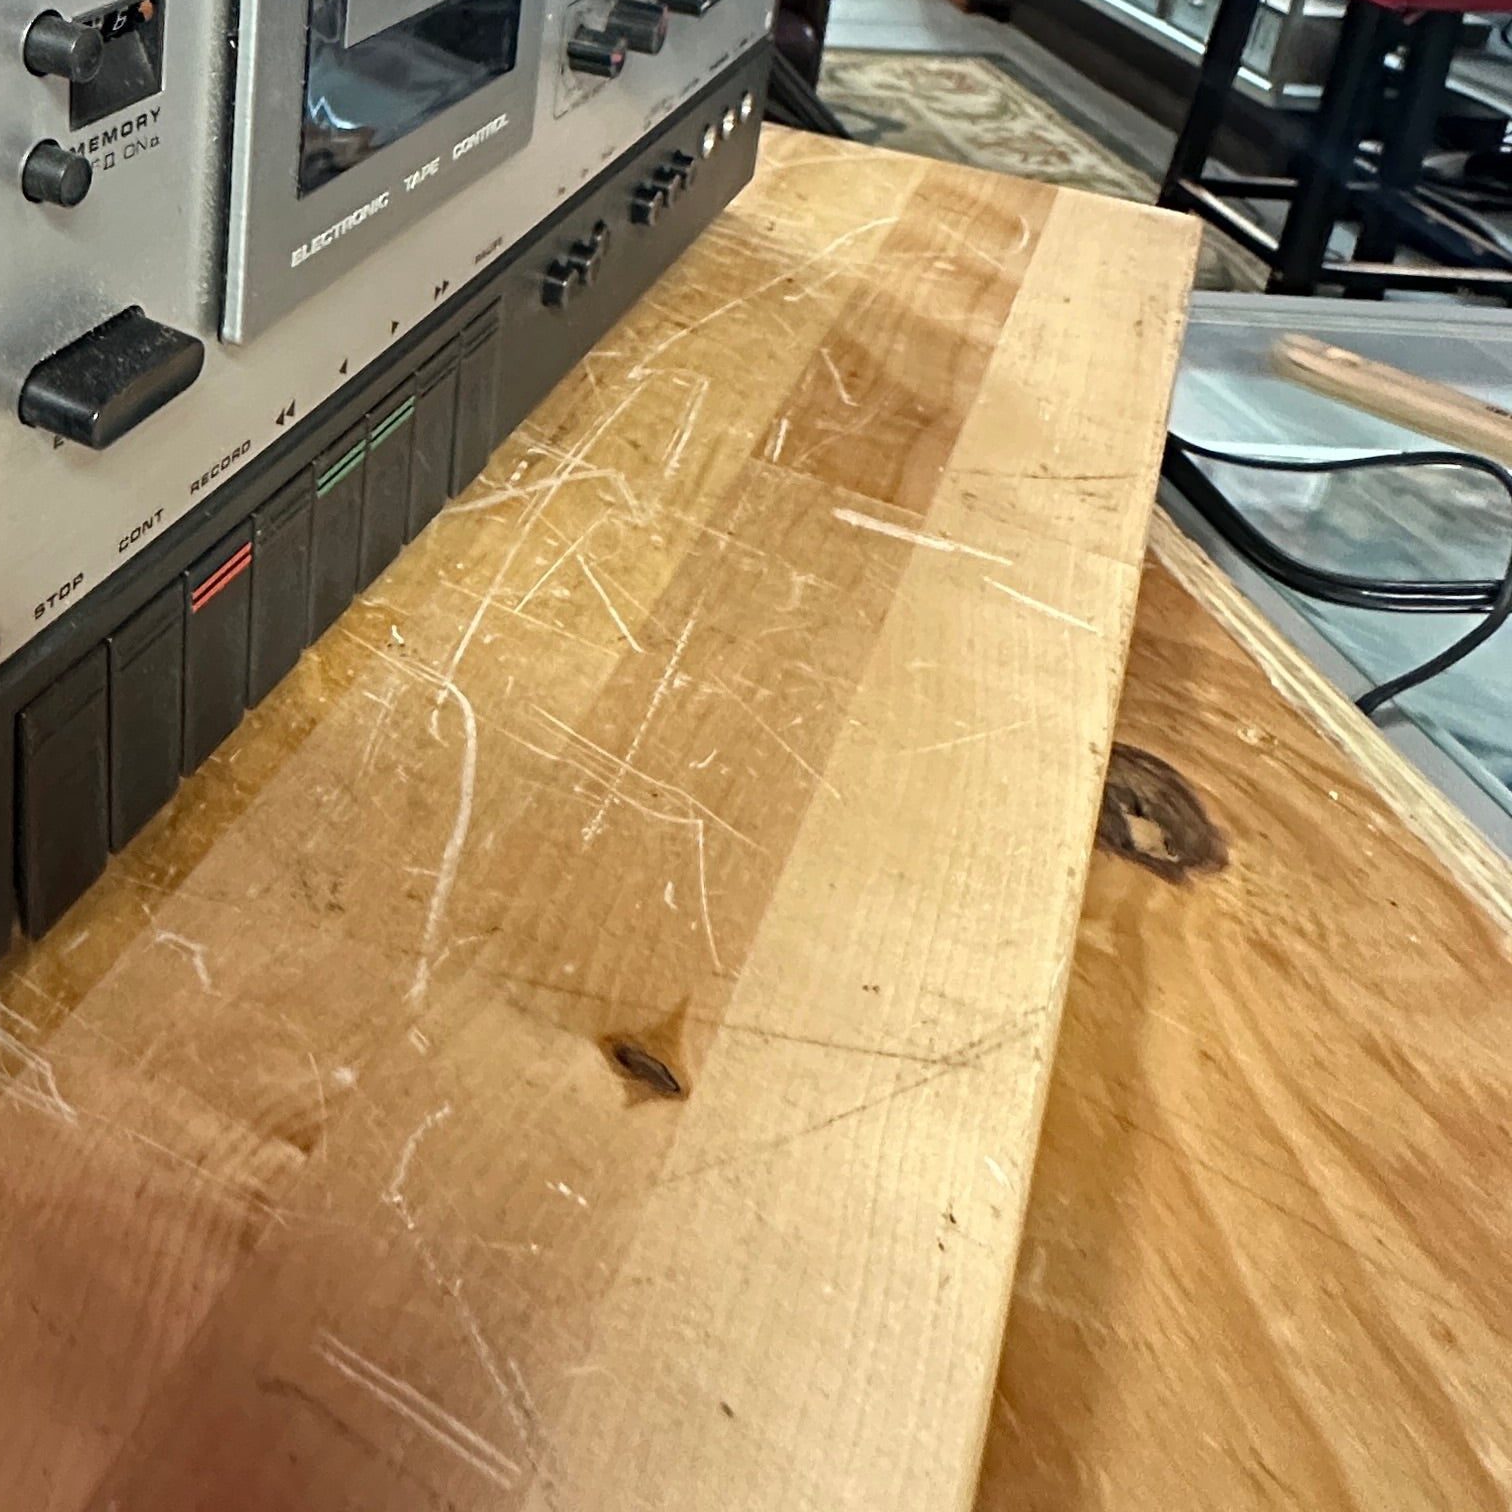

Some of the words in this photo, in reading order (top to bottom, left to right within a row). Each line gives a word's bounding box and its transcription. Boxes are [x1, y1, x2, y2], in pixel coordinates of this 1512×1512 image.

[70, 107, 161, 155] MEMORY
[291, 191, 390, 268] ELECTRONIC
[403, 157, 440, 192] TAPE
[452, 113, 509, 160] CONTROL
[34, 572, 85, 620] STOP
[118, 508, 164, 553] CONT
[190, 440, 251, 495] RECORD
